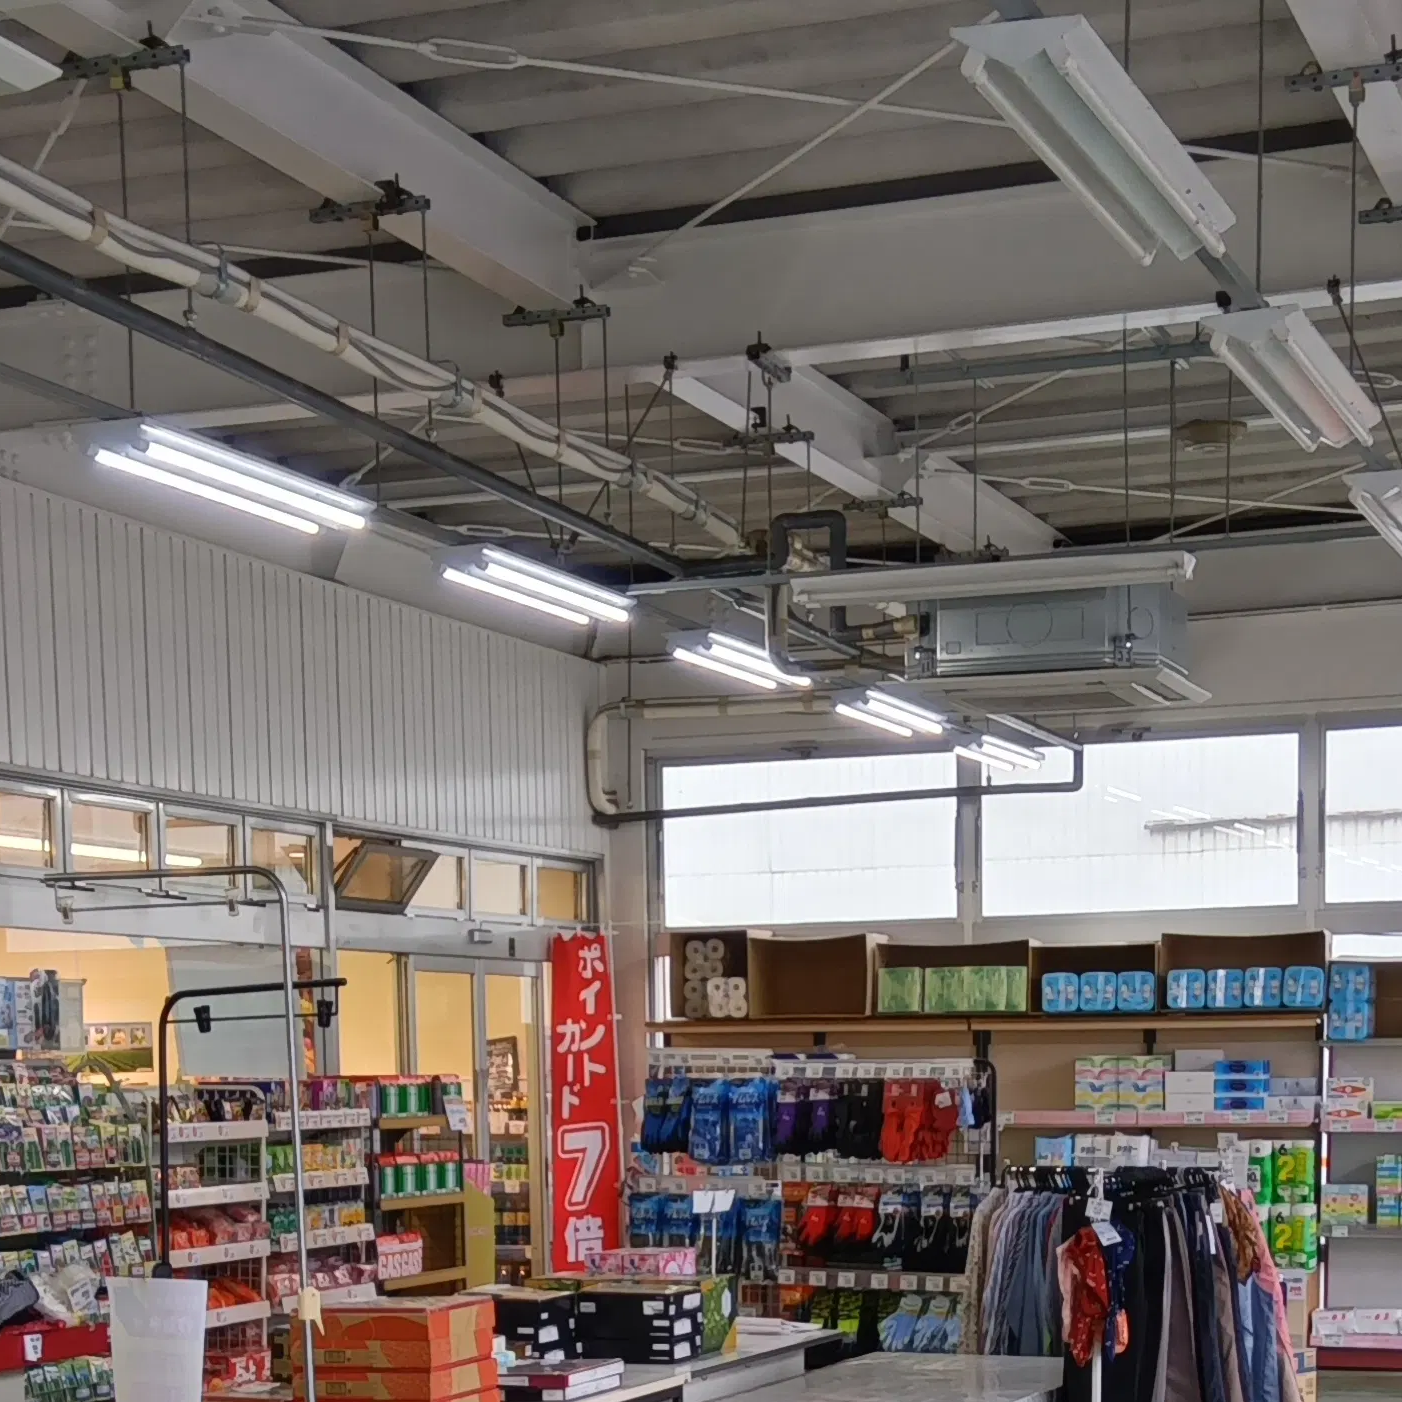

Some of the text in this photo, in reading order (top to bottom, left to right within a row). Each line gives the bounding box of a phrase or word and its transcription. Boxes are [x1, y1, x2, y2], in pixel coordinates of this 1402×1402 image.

[556, 1017, 589, 1120] カード
[579, 942, 606, 1087] ポイント
